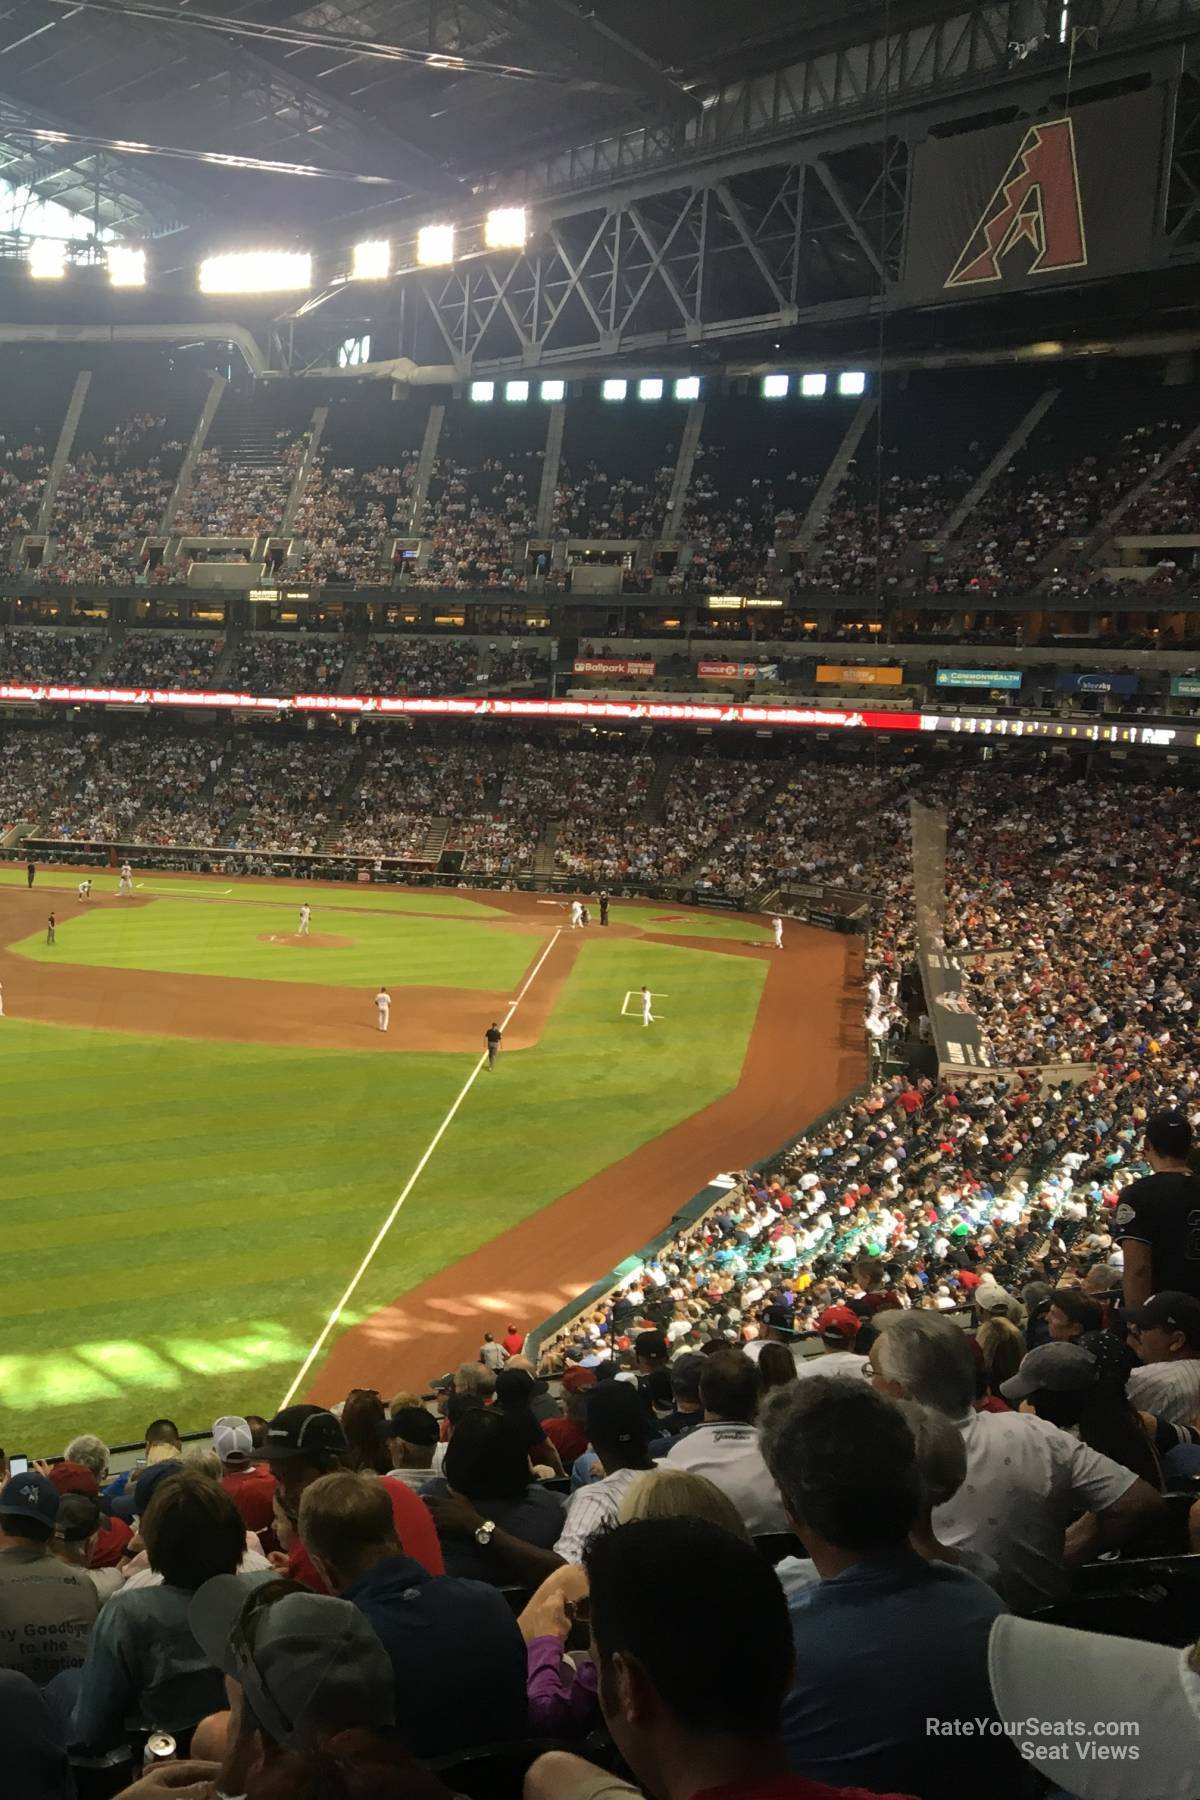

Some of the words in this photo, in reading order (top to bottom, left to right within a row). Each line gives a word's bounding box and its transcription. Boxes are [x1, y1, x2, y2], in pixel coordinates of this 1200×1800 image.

[585, 662, 625, 674] Ballpark
[19, 1642, 36, 1655] to
[42, 1639, 68, 1653] the
